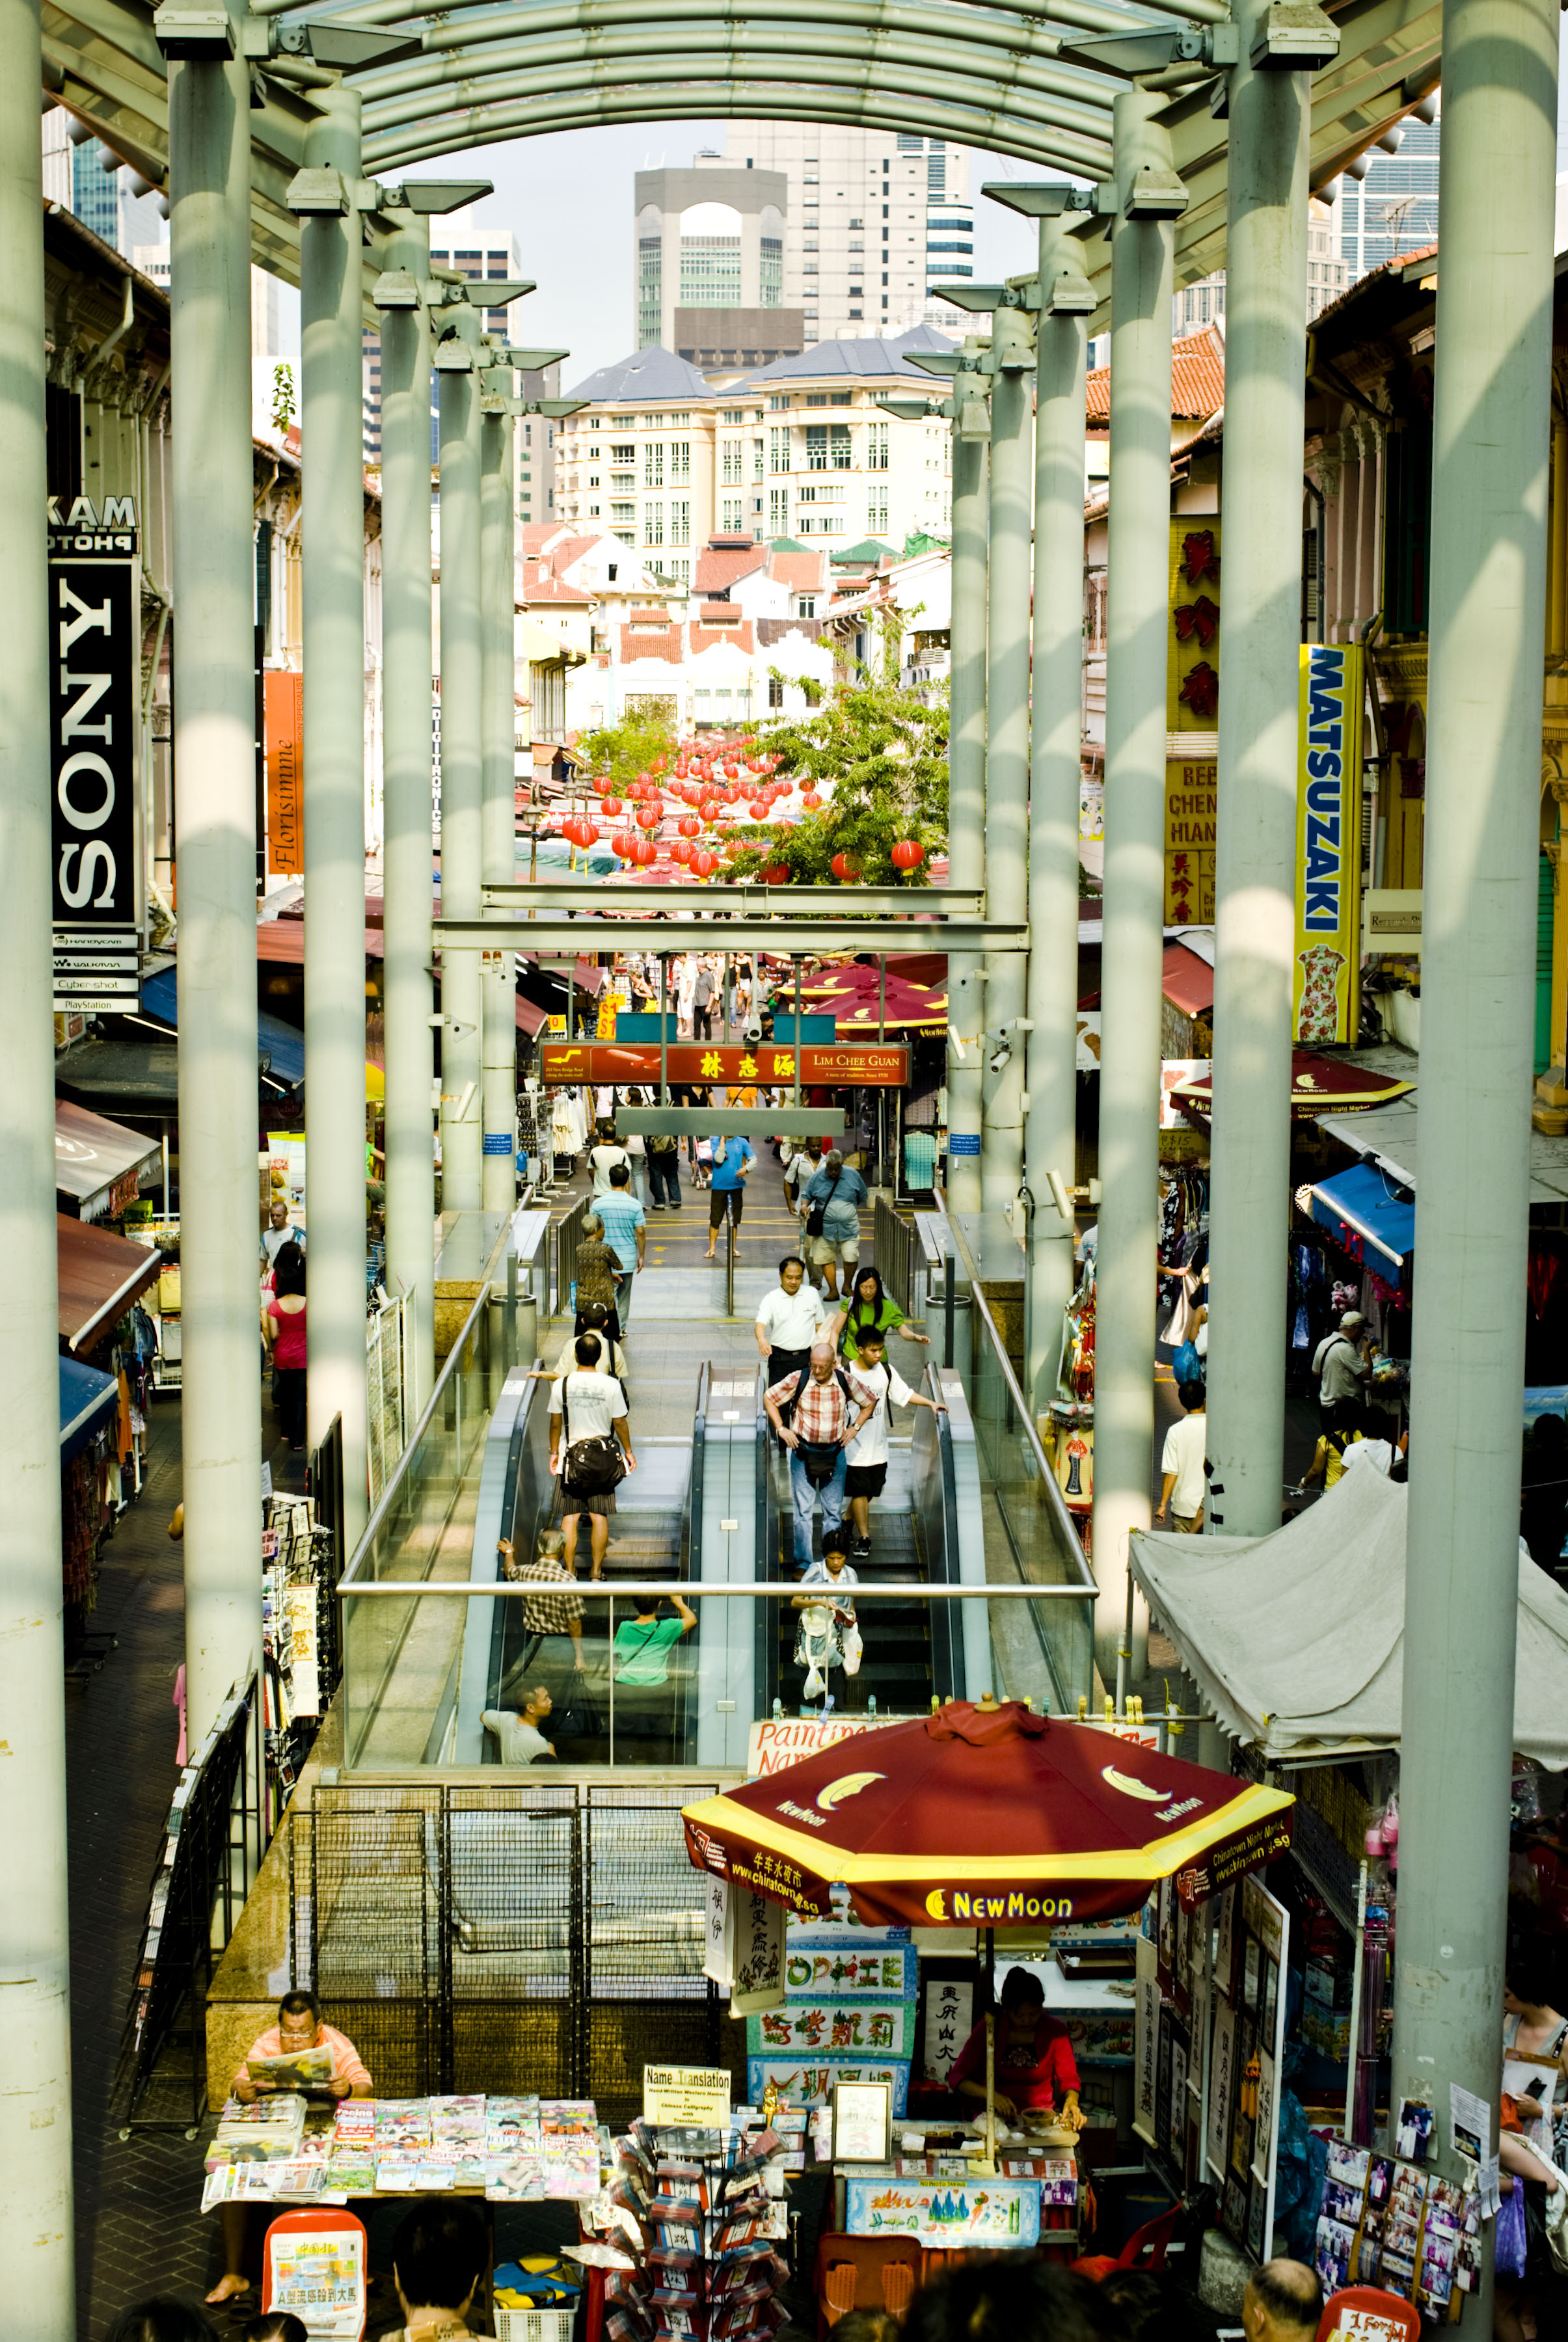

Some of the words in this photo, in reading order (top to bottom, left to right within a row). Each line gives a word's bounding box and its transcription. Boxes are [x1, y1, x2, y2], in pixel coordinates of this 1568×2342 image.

[57, 577, 116, 909] SONY
[432, 708, 441, 833] DIGITRONICS
[1183, 767, 1217, 786] BEE
[1305, 647, 1344, 932] MATSUZAKI
[270, 740, 295, 869] Florisimme
[65, 1001, 112, 1010] PlayStation
[814, 1055, 833, 1066] LIM
[837, 1055, 865, 1066] CHEE
[868, 1055, 900, 1066] GUAN
[753, 1852, 802, 1889] 牛车水夜市
[953, 1892, 1074, 1918] NewMoon
[647, 2067, 673, 2085] Name
[678, 2069, 729, 2089] Translation
[1350, 2313, 1361, 2329] 1
